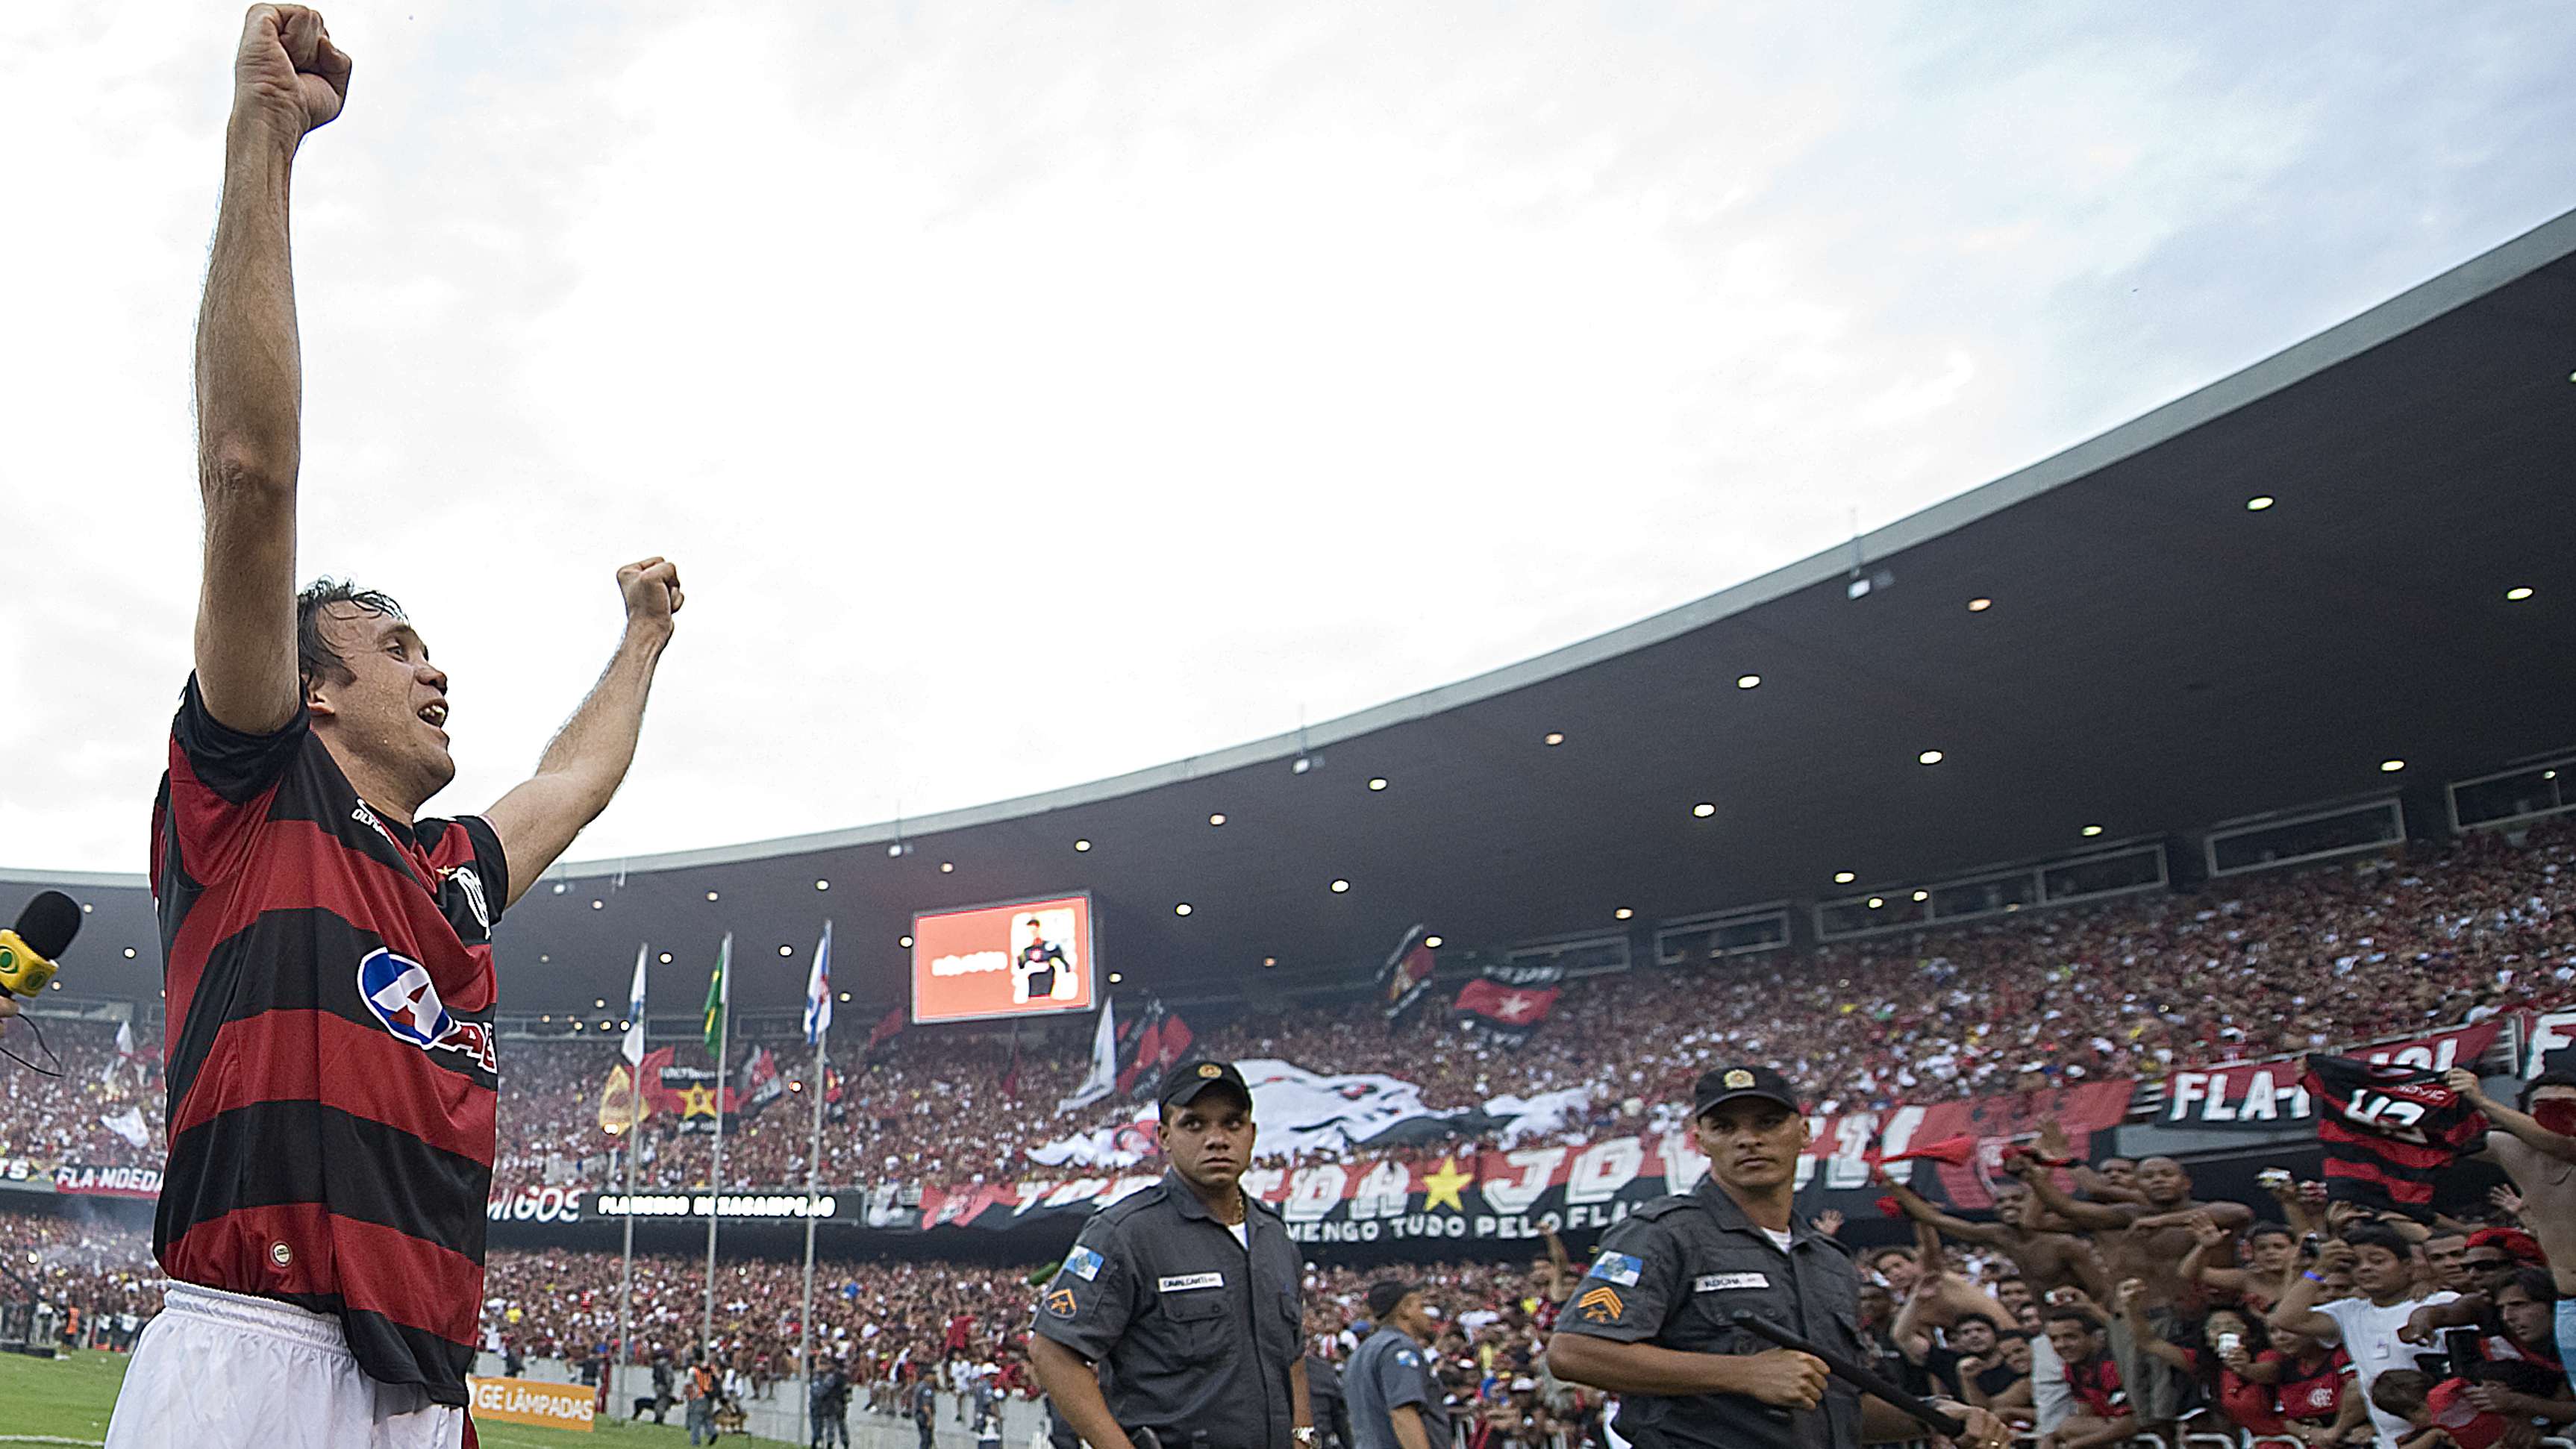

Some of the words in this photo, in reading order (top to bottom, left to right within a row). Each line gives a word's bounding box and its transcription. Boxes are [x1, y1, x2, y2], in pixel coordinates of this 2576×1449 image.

[1389, 1213, 1466, 1239] TUDO
[1475, 1211, 1563, 1239] PELO
[1568, 1200, 1643, 1230] FLA
[478, 1384, 504, 1410] GE
[505, 1387, 595, 1421] LÂMPADAS
